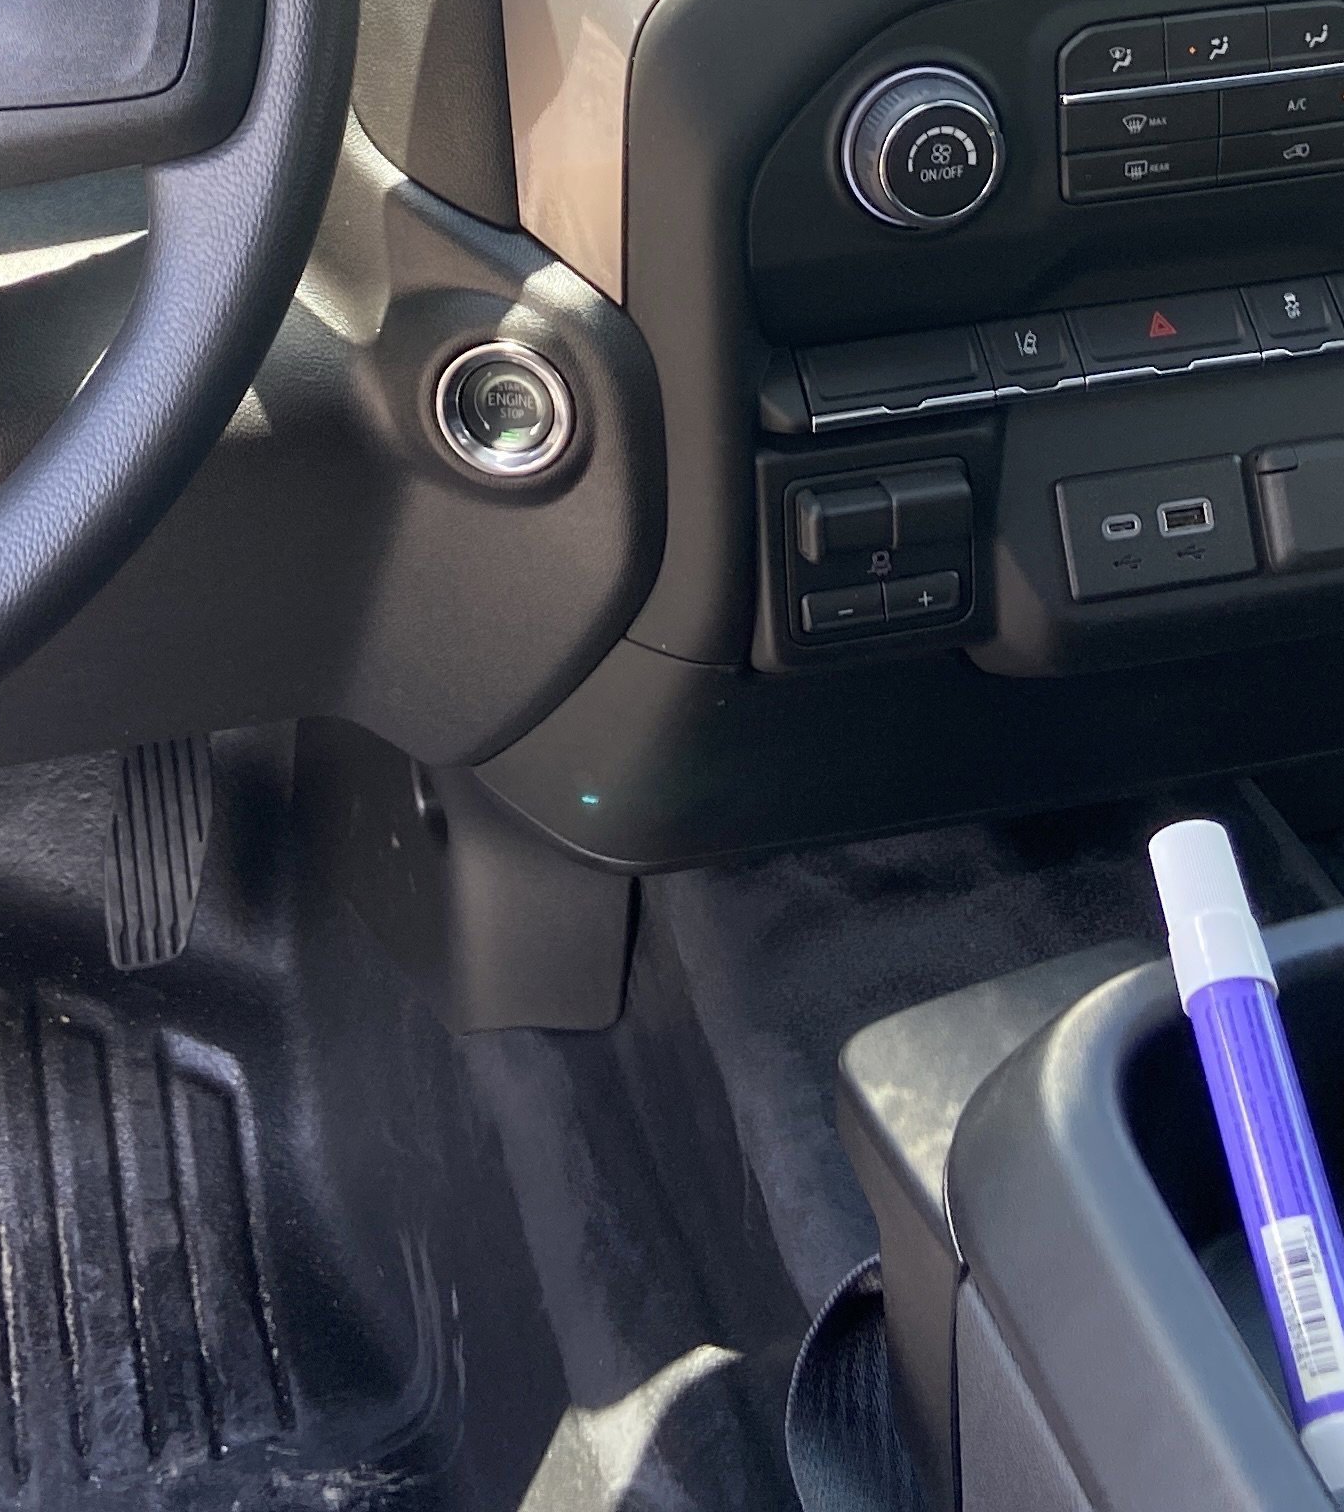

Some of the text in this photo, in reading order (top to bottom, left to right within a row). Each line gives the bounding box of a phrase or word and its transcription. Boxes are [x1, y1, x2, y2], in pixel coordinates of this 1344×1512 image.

[1287, 96, 1307, 113] A/C
[1149, 116, 1168, 127] MAX
[920, 165, 964, 183] ON/OFF
[488, 391, 534, 410] ENGINE
[500, 407, 525, 419] STOP
